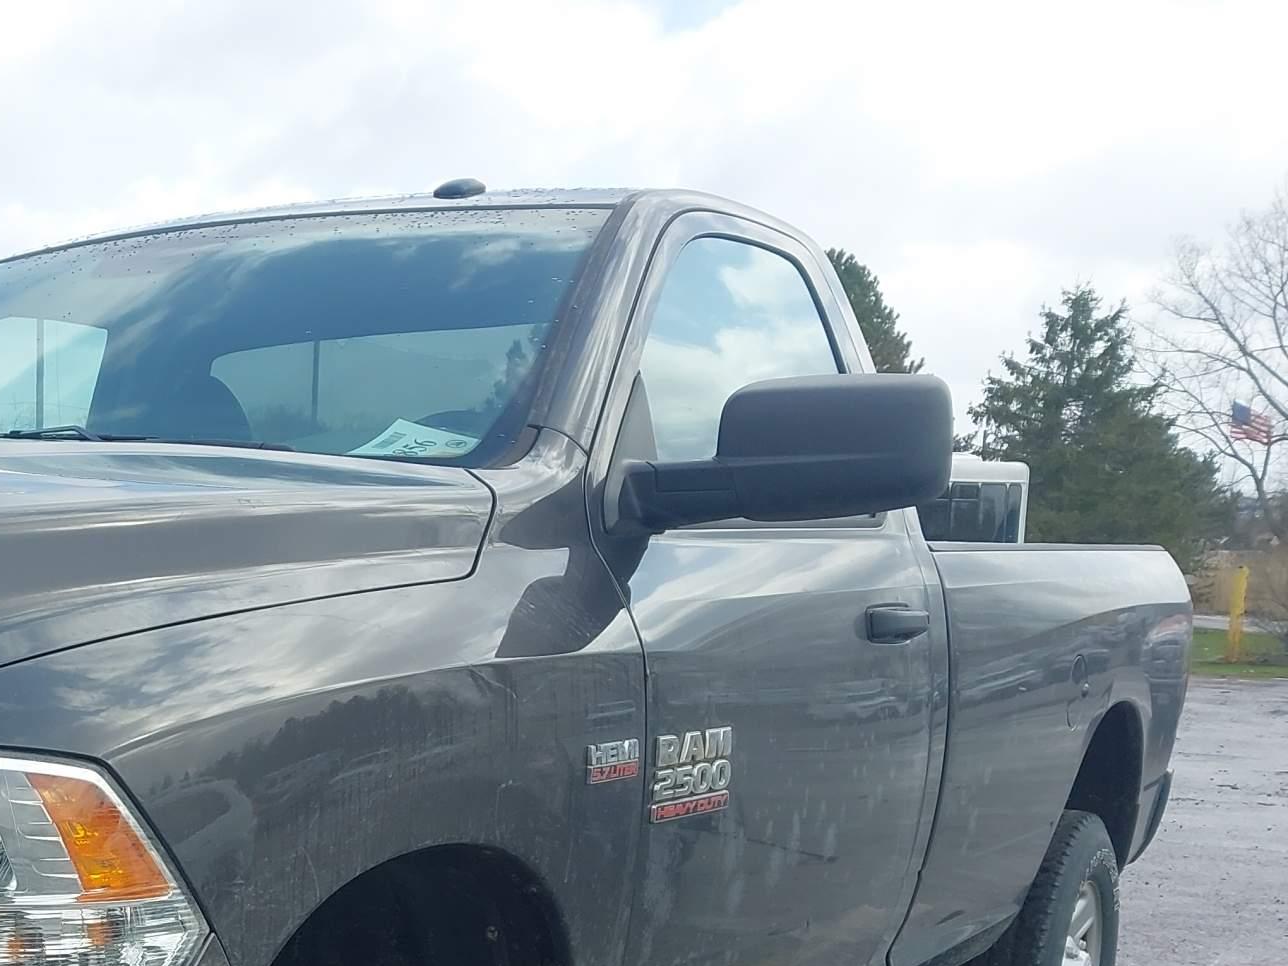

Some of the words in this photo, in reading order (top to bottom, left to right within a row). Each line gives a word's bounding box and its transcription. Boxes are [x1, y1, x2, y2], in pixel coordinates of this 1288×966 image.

[384, 438, 438, 457] 856
[587, 739, 639, 766] HEMI
[656, 726, 732, 768] RAM
[652, 759, 732, 801] 2500
[657, 801, 696, 819] HEAVY
[697, 794, 728, 812] DUTY
